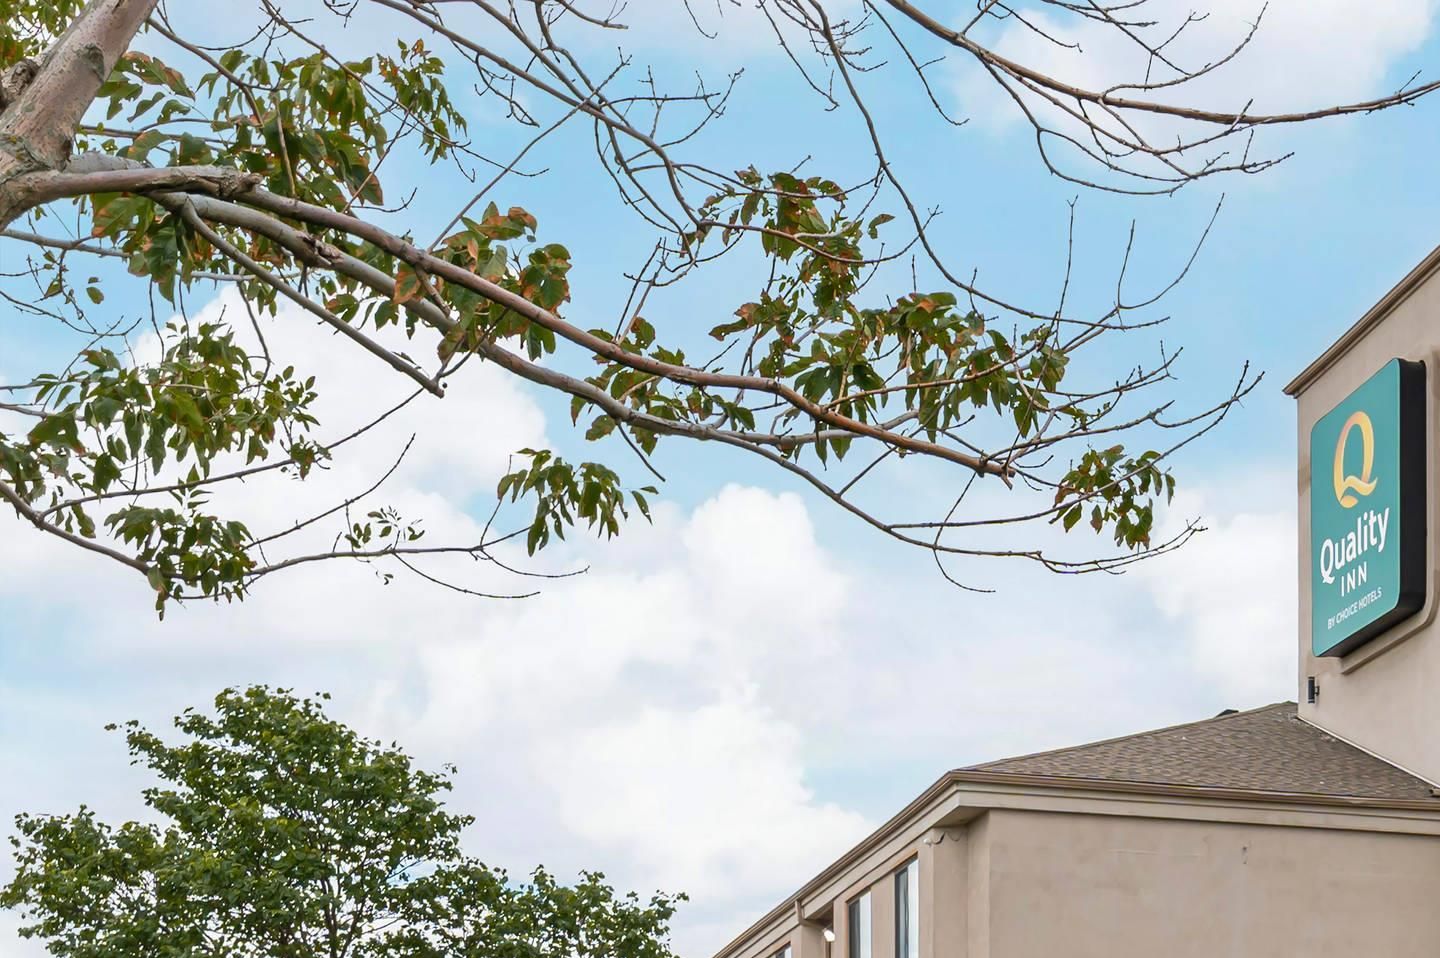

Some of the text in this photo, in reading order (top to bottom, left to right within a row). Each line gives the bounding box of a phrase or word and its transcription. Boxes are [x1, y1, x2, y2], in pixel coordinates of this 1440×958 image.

[1333, 411, 1378, 509] Q
[1319, 507, 1390, 584] Quality
[1327, 587, 1382, 630] BY CHOICE HOTELS
[1340, 561, 1368, 598] INN
